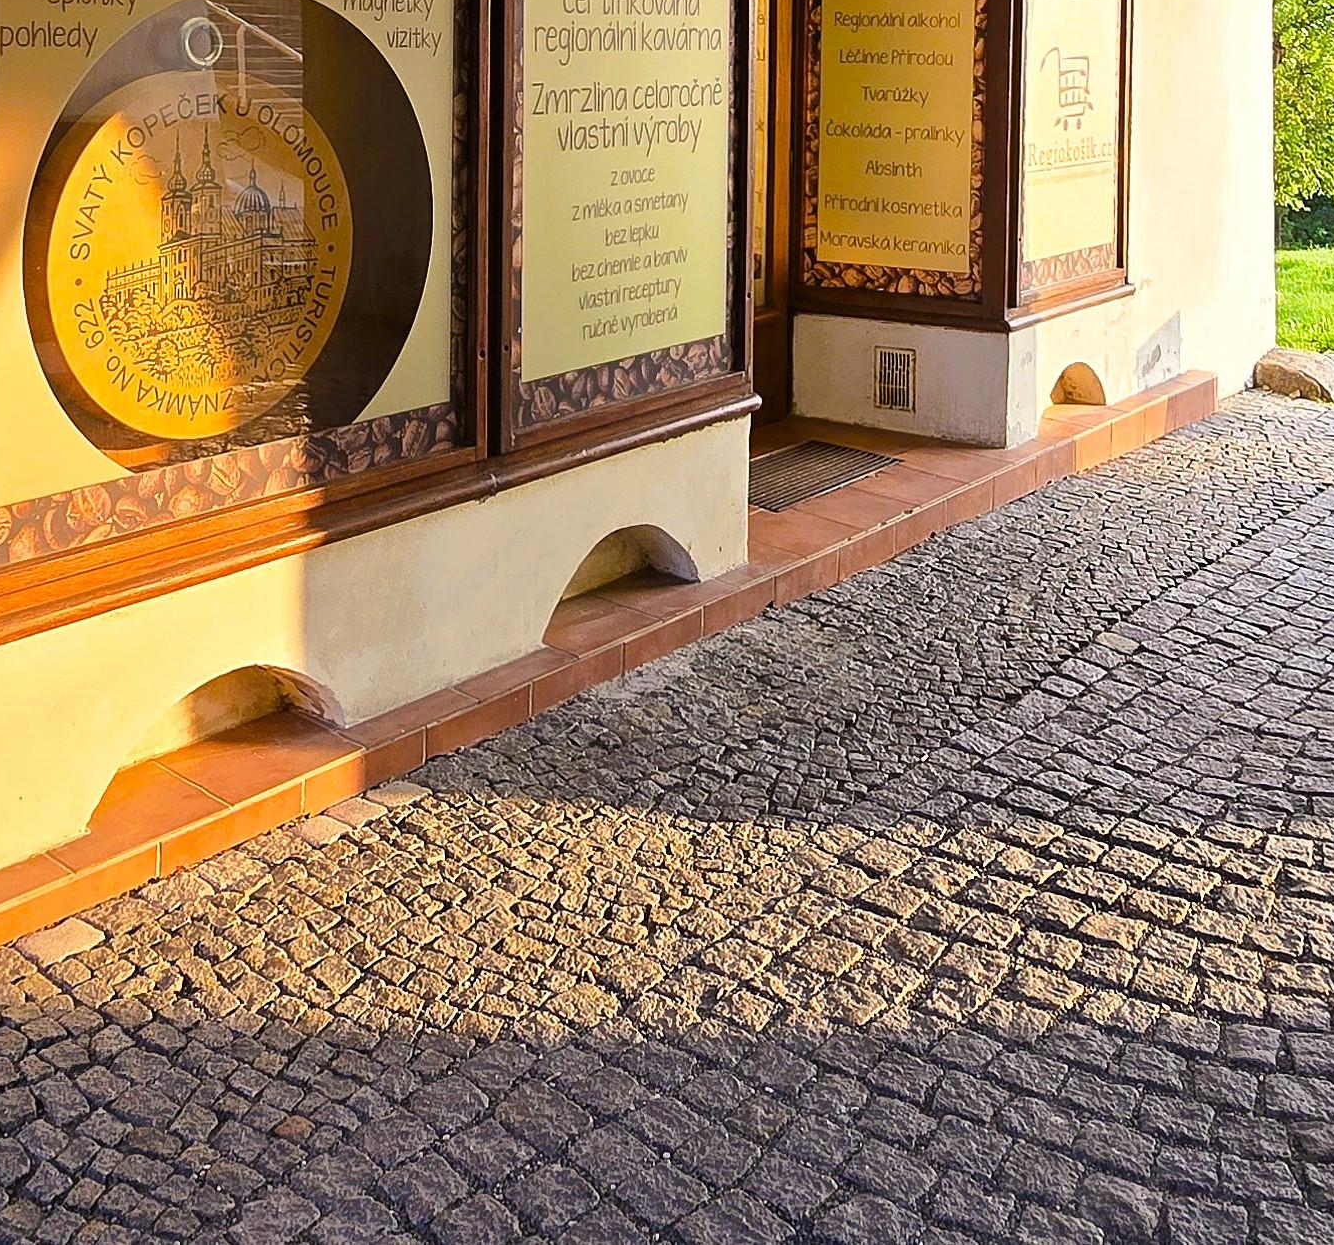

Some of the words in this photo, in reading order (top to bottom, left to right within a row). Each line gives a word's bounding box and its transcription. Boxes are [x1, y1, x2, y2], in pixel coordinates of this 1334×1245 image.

[0, 20, 98, 57] pohledy
[833, 11, 906, 32] Regionální
[908, 13, 961, 29] alkohol
[386, 27, 441, 56] vizitky
[533, 20, 637, 66] regionální
[640, 21, 722, 52] kavárna
[532, 82, 628, 115] Zmrzlina
[633, 77, 723, 110] celoročně
[557, 116, 630, 151] vlastní
[634, 114, 702, 158] výroby
[826, 119, 892, 139] Čokoláda
[904, 125, 965, 147] pralinky
[70, 164, 114, 261] SVATÝ
[110, 92, 228, 165] KOPEČEK
[235, 97, 254, 117] U
[257, 104, 339, 230] OLOMOUCE
[610, 170, 618, 186] z
[620, 166, 656, 185] ovoce
[865, 161, 923, 178] Absinth
[572, 205, 581, 221] z
[582, 197, 623, 219] mléka
[624, 200, 633, 213] a
[635, 191, 689, 219] smetany
[881, 198, 963, 218] kosmetika
[605, 227, 627, 247] bez
[629, 223, 660, 245] lepku
[820, 231, 891, 249] Moravská
[893, 236, 966, 256] keramika
[572, 261, 596, 282] bez
[597, 253, 642, 276] chemie
[643, 254, 652, 269] a
[654, 245, 688, 267] barviv
[579, 284, 622, 311] vlastní
[623, 275, 682, 304] receptury
[73, 298, 105, 350] 622
[582, 317, 619, 341] ručně
[621, 304, 678, 337] vyrobená
[137, 378, 235, 422] ZNÁMKA
